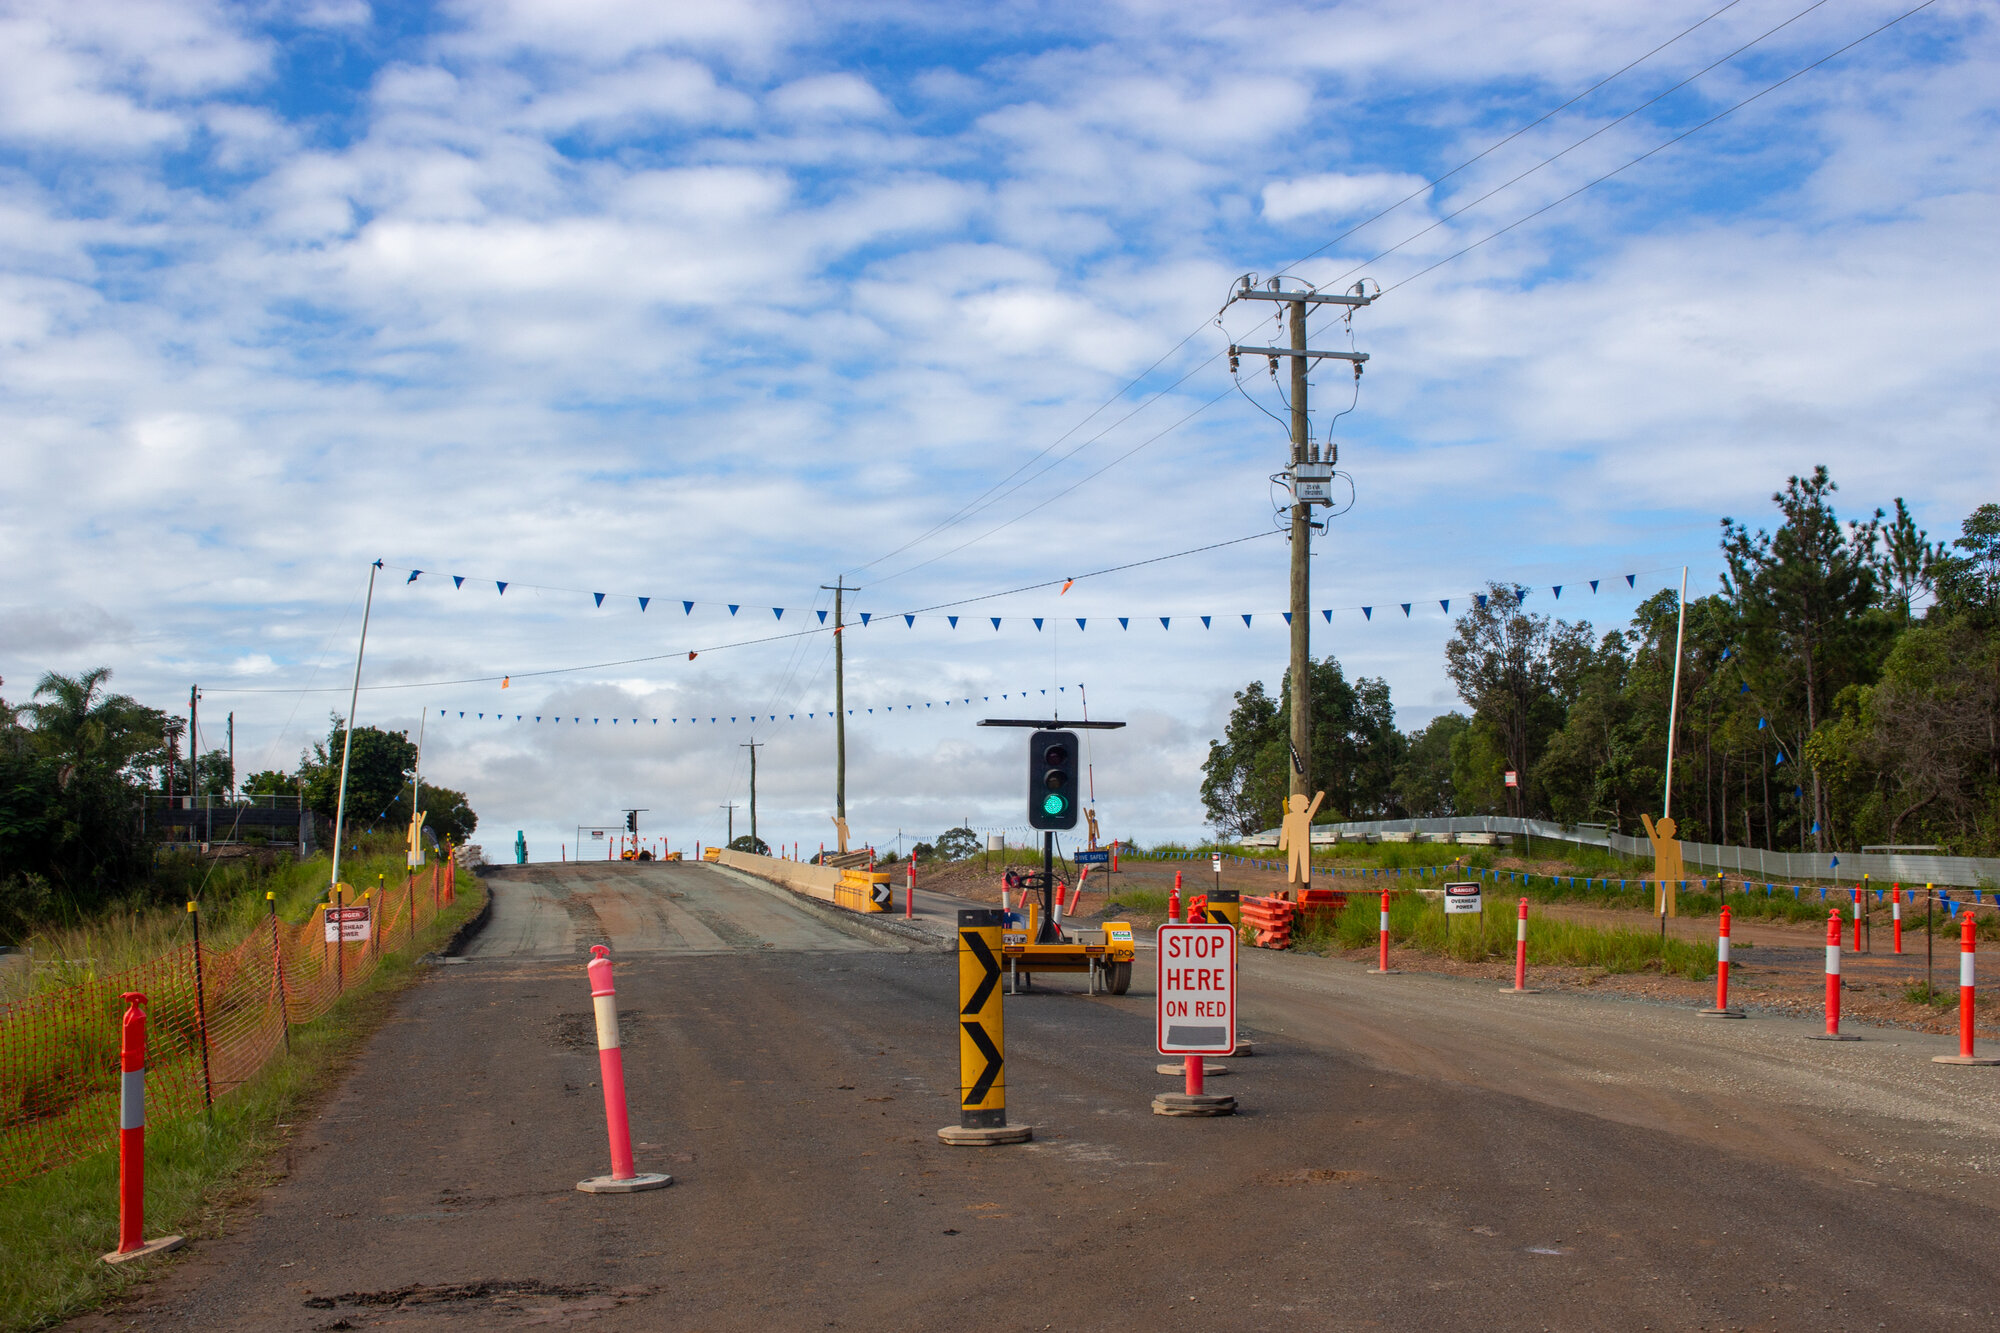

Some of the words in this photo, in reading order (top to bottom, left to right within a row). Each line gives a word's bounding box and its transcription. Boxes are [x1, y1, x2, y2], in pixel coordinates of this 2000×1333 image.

[1090, 853, 1108, 861] SAFELY
[1168, 935, 1225, 958] STOP
[1167, 969, 1225, 991] HERE
[1166, 1001, 1188, 1017] ON
[1195, 1001, 1226, 1017] RED
